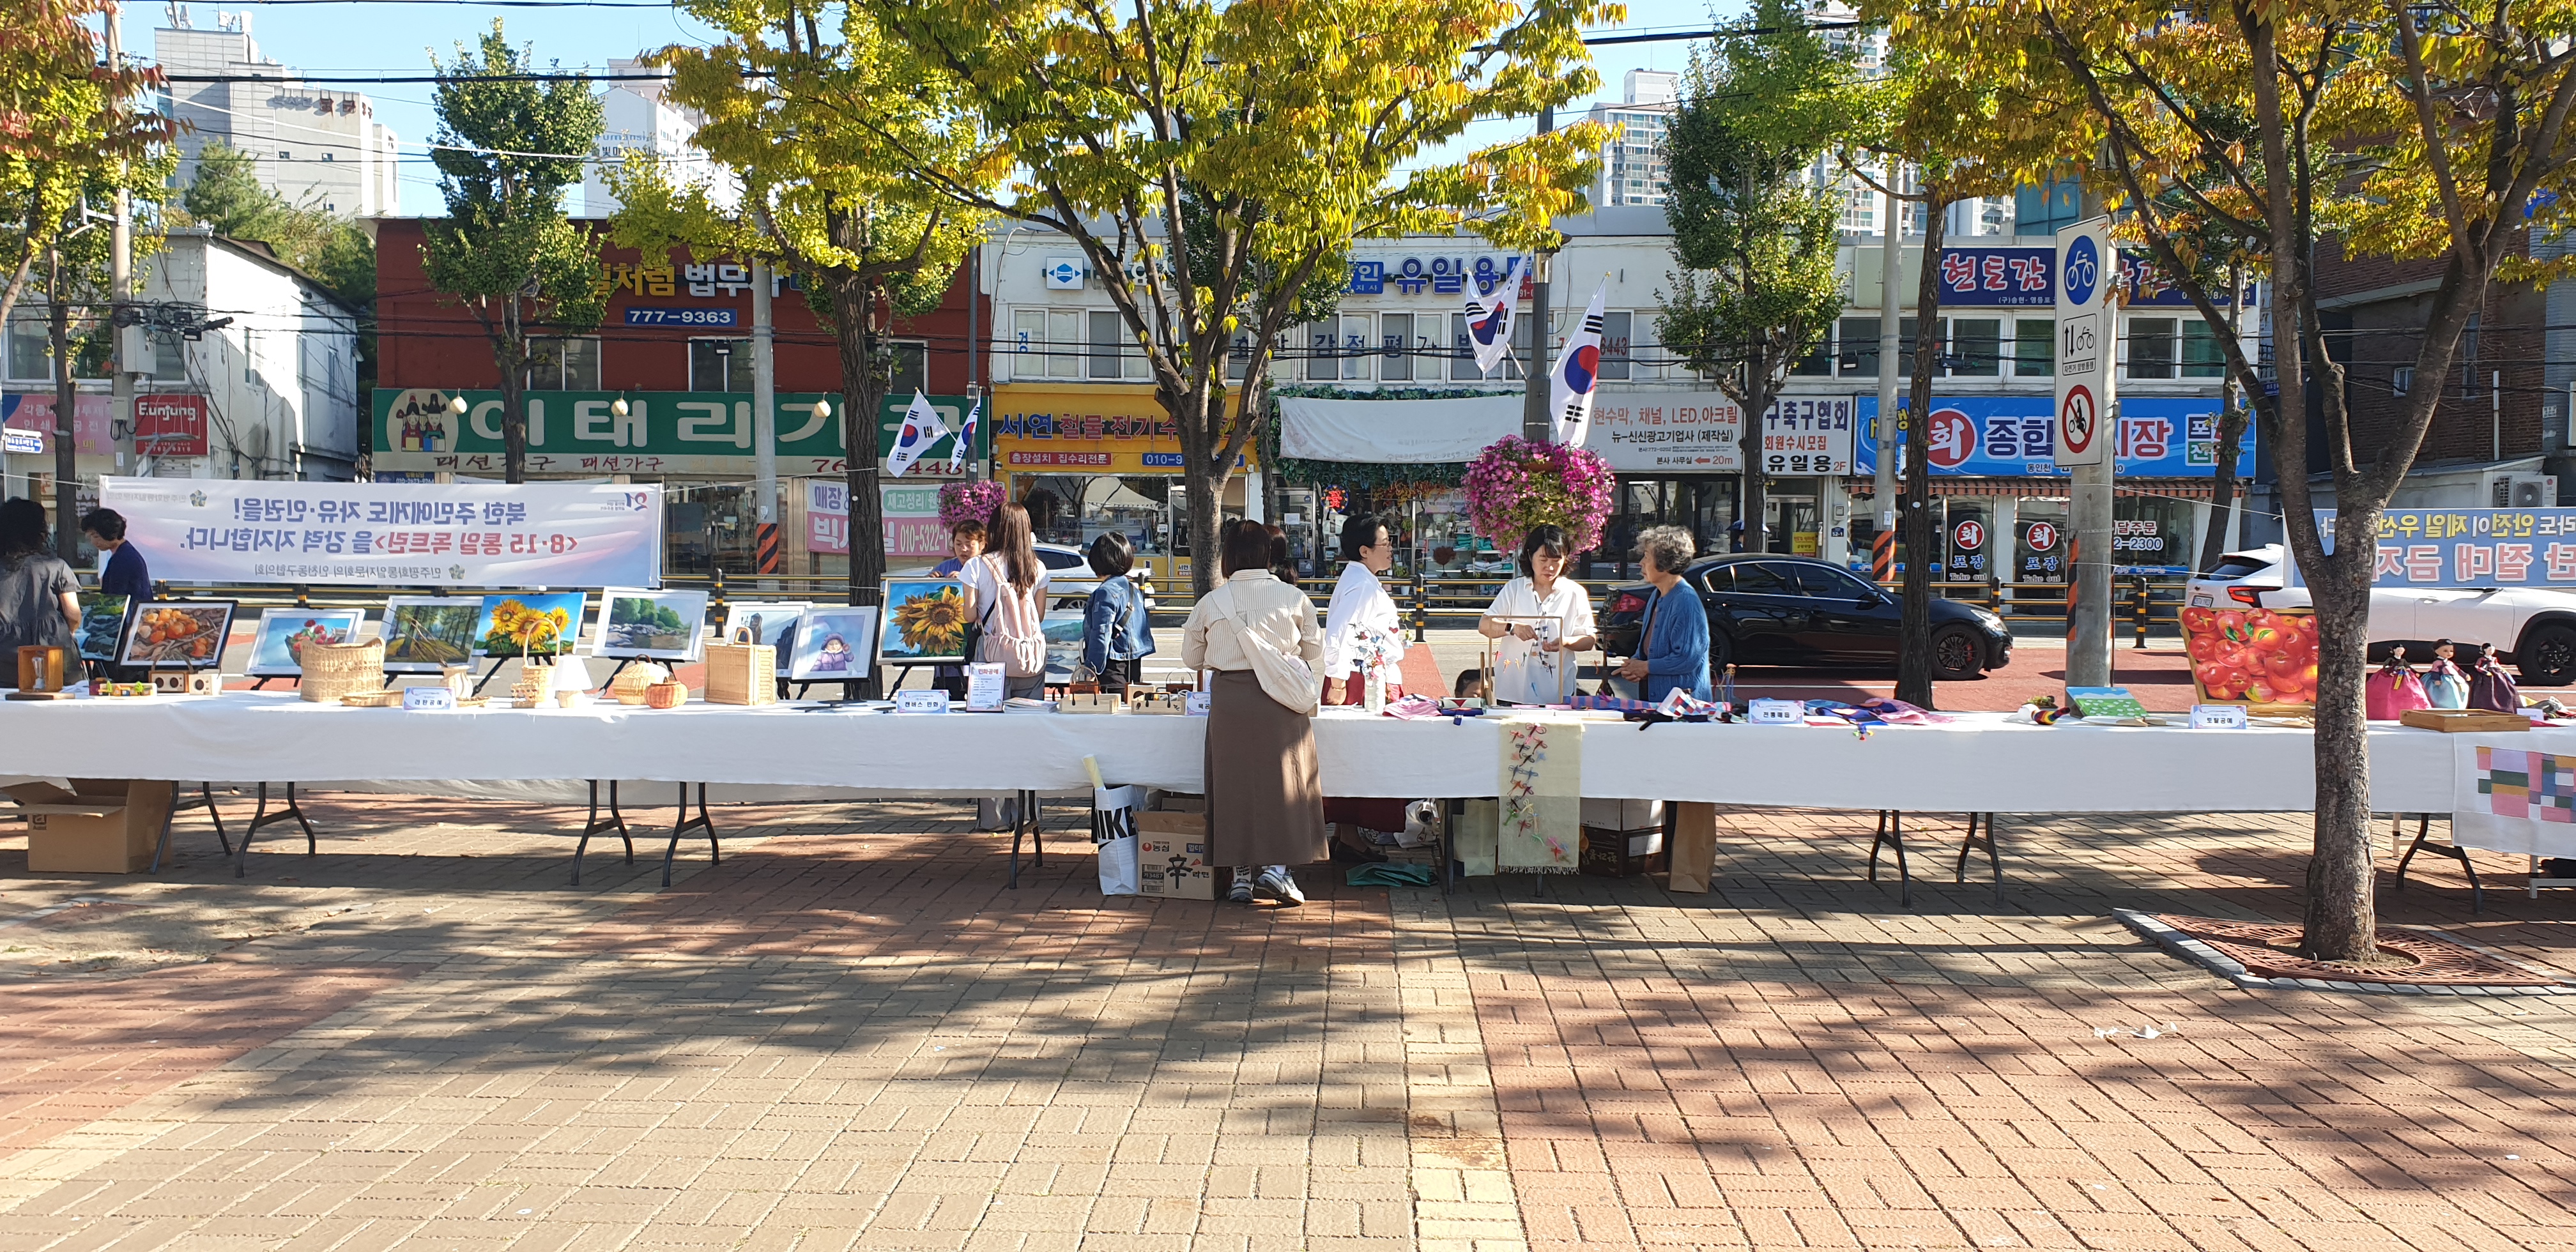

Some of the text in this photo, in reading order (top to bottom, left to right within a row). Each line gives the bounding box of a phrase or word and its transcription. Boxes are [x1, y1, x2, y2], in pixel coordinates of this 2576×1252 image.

[1395, 256, 1501, 296] 유일용
[630, 310, 731, 323] 777-9363
[139, 402, 196, 421] Eunjung
[1639, 406, 1666, 425] 채널,
[998, 413, 1053, 439] 서연
[1058, 413, 1104, 440] 철물
[1698, 429, 1733, 443] (제작실)
[1765, 435, 1827, 451] 회원수시모집
[1928, 418, 1965, 459] 회
[434, 454, 556, 471] 패션구
[1058, 453, 1107, 464] 집수리전문
[1657, 455, 1733, 465] 본사 사무실 20m
[1768, 455, 1847, 472] 유일용 2F
[2027, 464, 2051, 473] 동인천
[814, 486, 842, 510] 매장
[1959, 525, 1979, 546] 회
[2114, 521, 2158, 535] 달주문
[2032, 526, 2051, 547] 회
[2114, 537, 2163, 550] 2-2300
[1952, 555, 1985, 570] 포장
[2025, 556, 2058, 571] 포장
[1949, 573, 1970, 581] Take
[2023, 574, 2043, 583] Take
[1166, 853, 1193, 890] 辛
[1192, 871, 1209, 879] 라면
